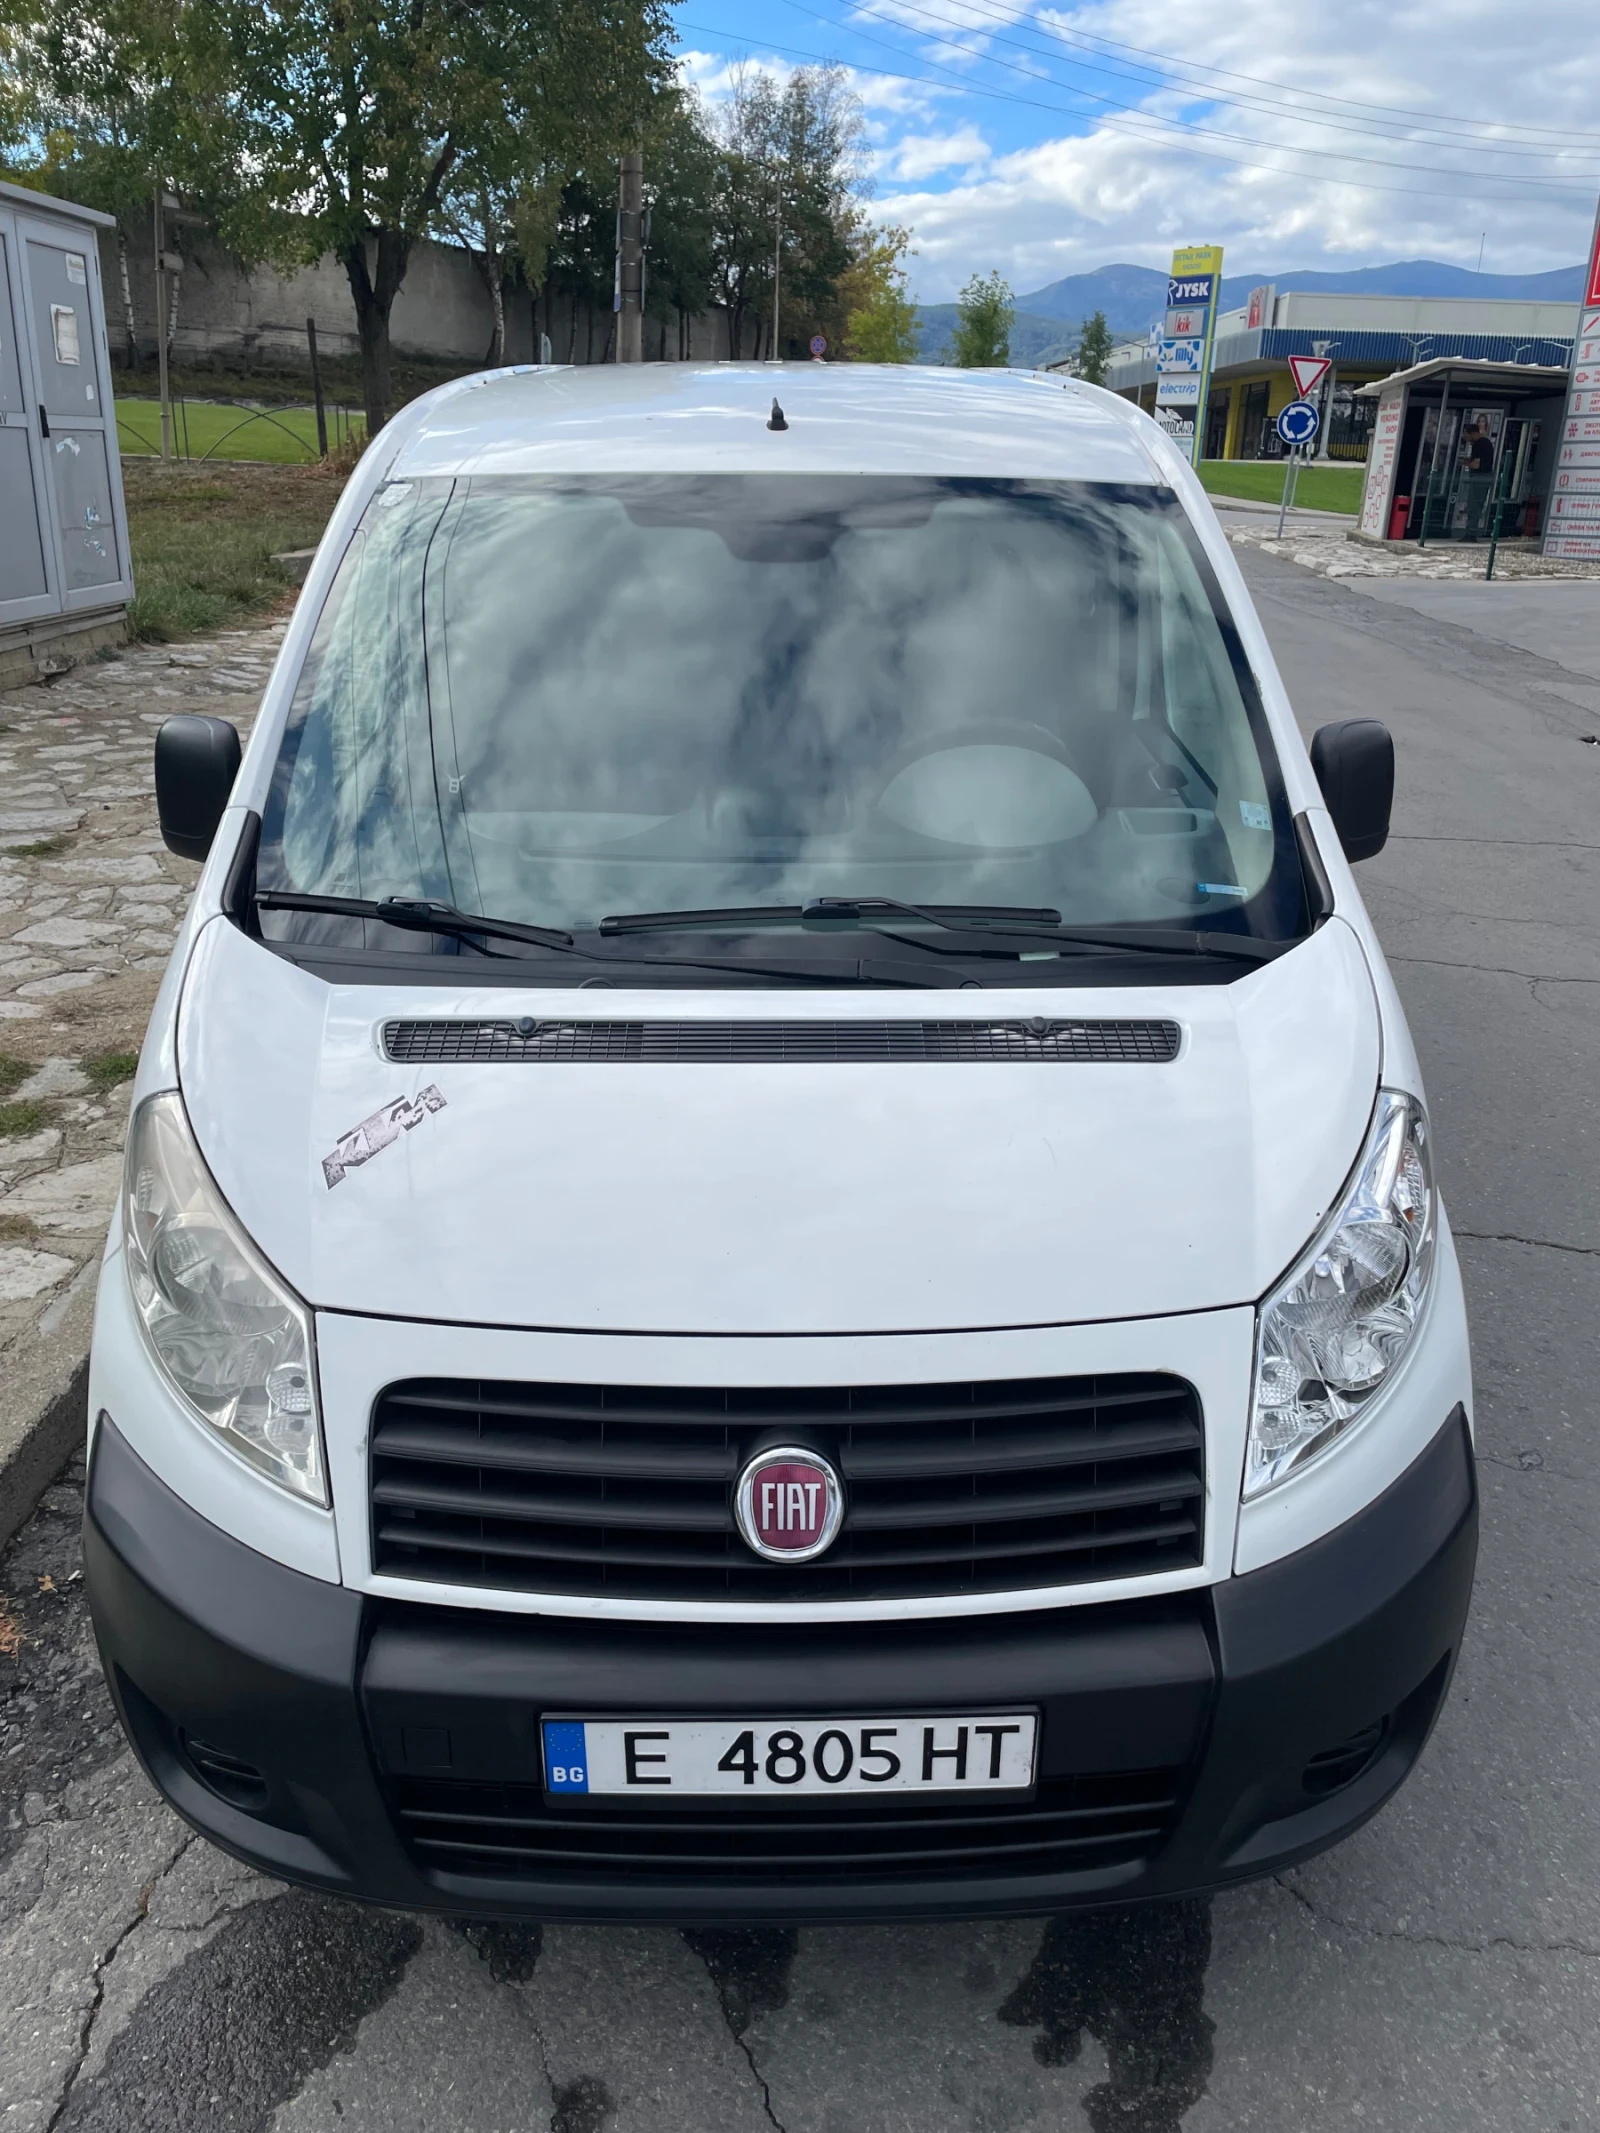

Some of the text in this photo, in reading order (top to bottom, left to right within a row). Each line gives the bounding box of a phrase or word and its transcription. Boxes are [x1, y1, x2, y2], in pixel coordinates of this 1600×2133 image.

[1175, 282, 1209, 298] JYSK
[1176, 316, 1191, 332] kik
[1175, 348, 1193, 365] lilly
[1160, 382, 1197, 395] electrip
[1158, 420, 1194, 434] OTOLAND
[761, 1483, 821, 1530] FIAT
[624, 1725, 1020, 1785] E 4805 HT
[553, 1767, 584, 1783] BG
